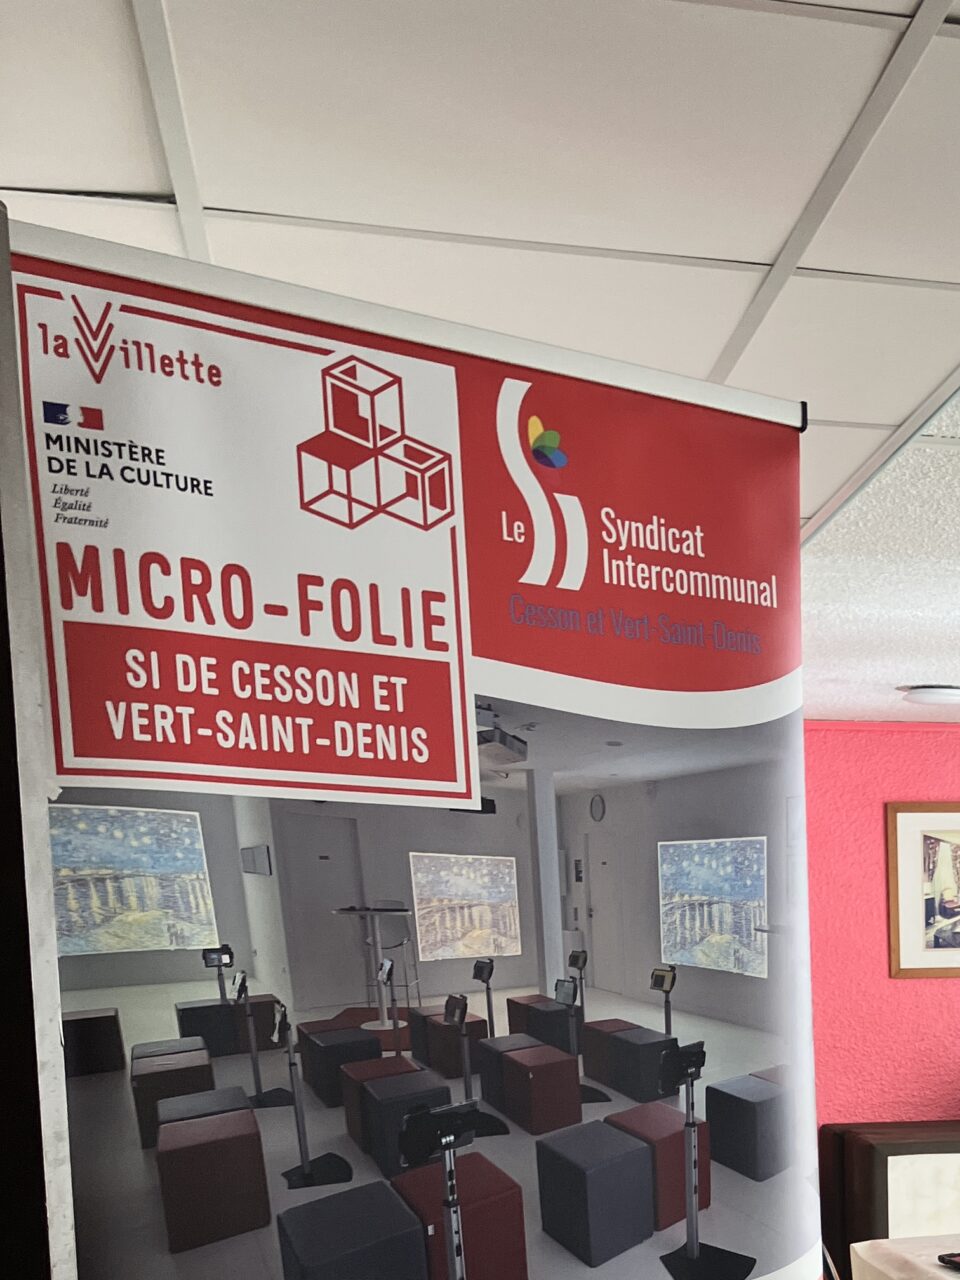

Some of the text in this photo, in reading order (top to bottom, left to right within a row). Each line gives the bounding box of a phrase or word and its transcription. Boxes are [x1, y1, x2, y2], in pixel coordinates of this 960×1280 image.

[44, 432, 166, 467] MINISTÈRE
[47, 456, 214, 497] DE LA CULTURE
[51, 483, 90, 498] Liberté
[52, 497, 92, 513] Égalité
[54, 512, 109, 529] Fraternité
[501, 511, 526, 544] Le
[600, 507, 706, 557] Syndicat
[602, 549, 778, 609] Intercommunal
[508, 594, 762, 656] Cesson et Vert-Saint-Denis
[125, 649, 408, 712] SI DE CESSON ET
[105, 700, 429, 762] VERT-SAINT-DENIS
